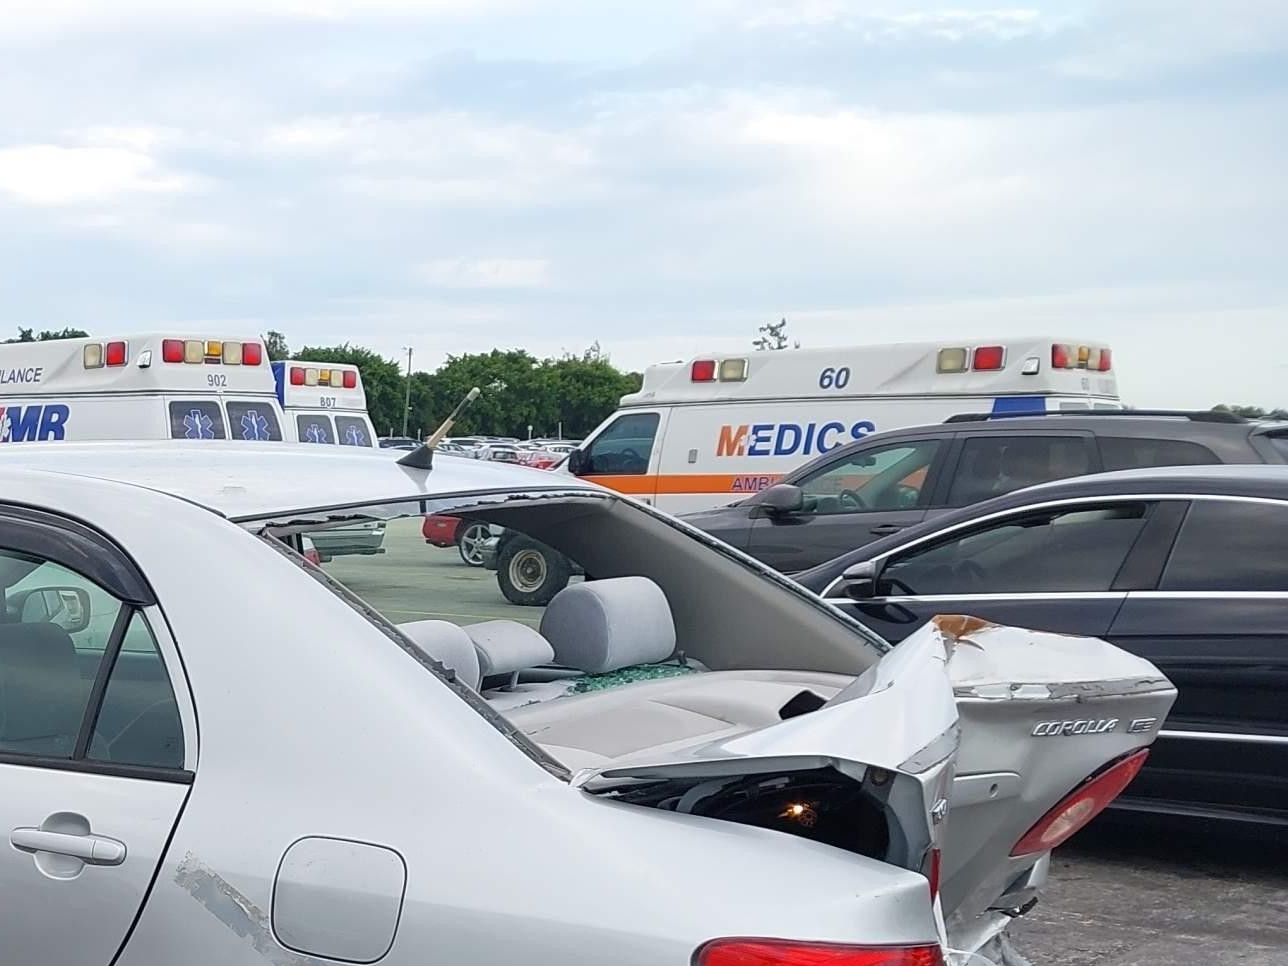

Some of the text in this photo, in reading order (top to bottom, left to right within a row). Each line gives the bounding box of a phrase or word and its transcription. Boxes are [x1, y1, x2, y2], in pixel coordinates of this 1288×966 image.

[207, 374, 228, 387] 902
[818, 366, 850, 390] 60
[320, 396, 337, 408] 807
[1031, 718, 1120, 737] COROLLA
